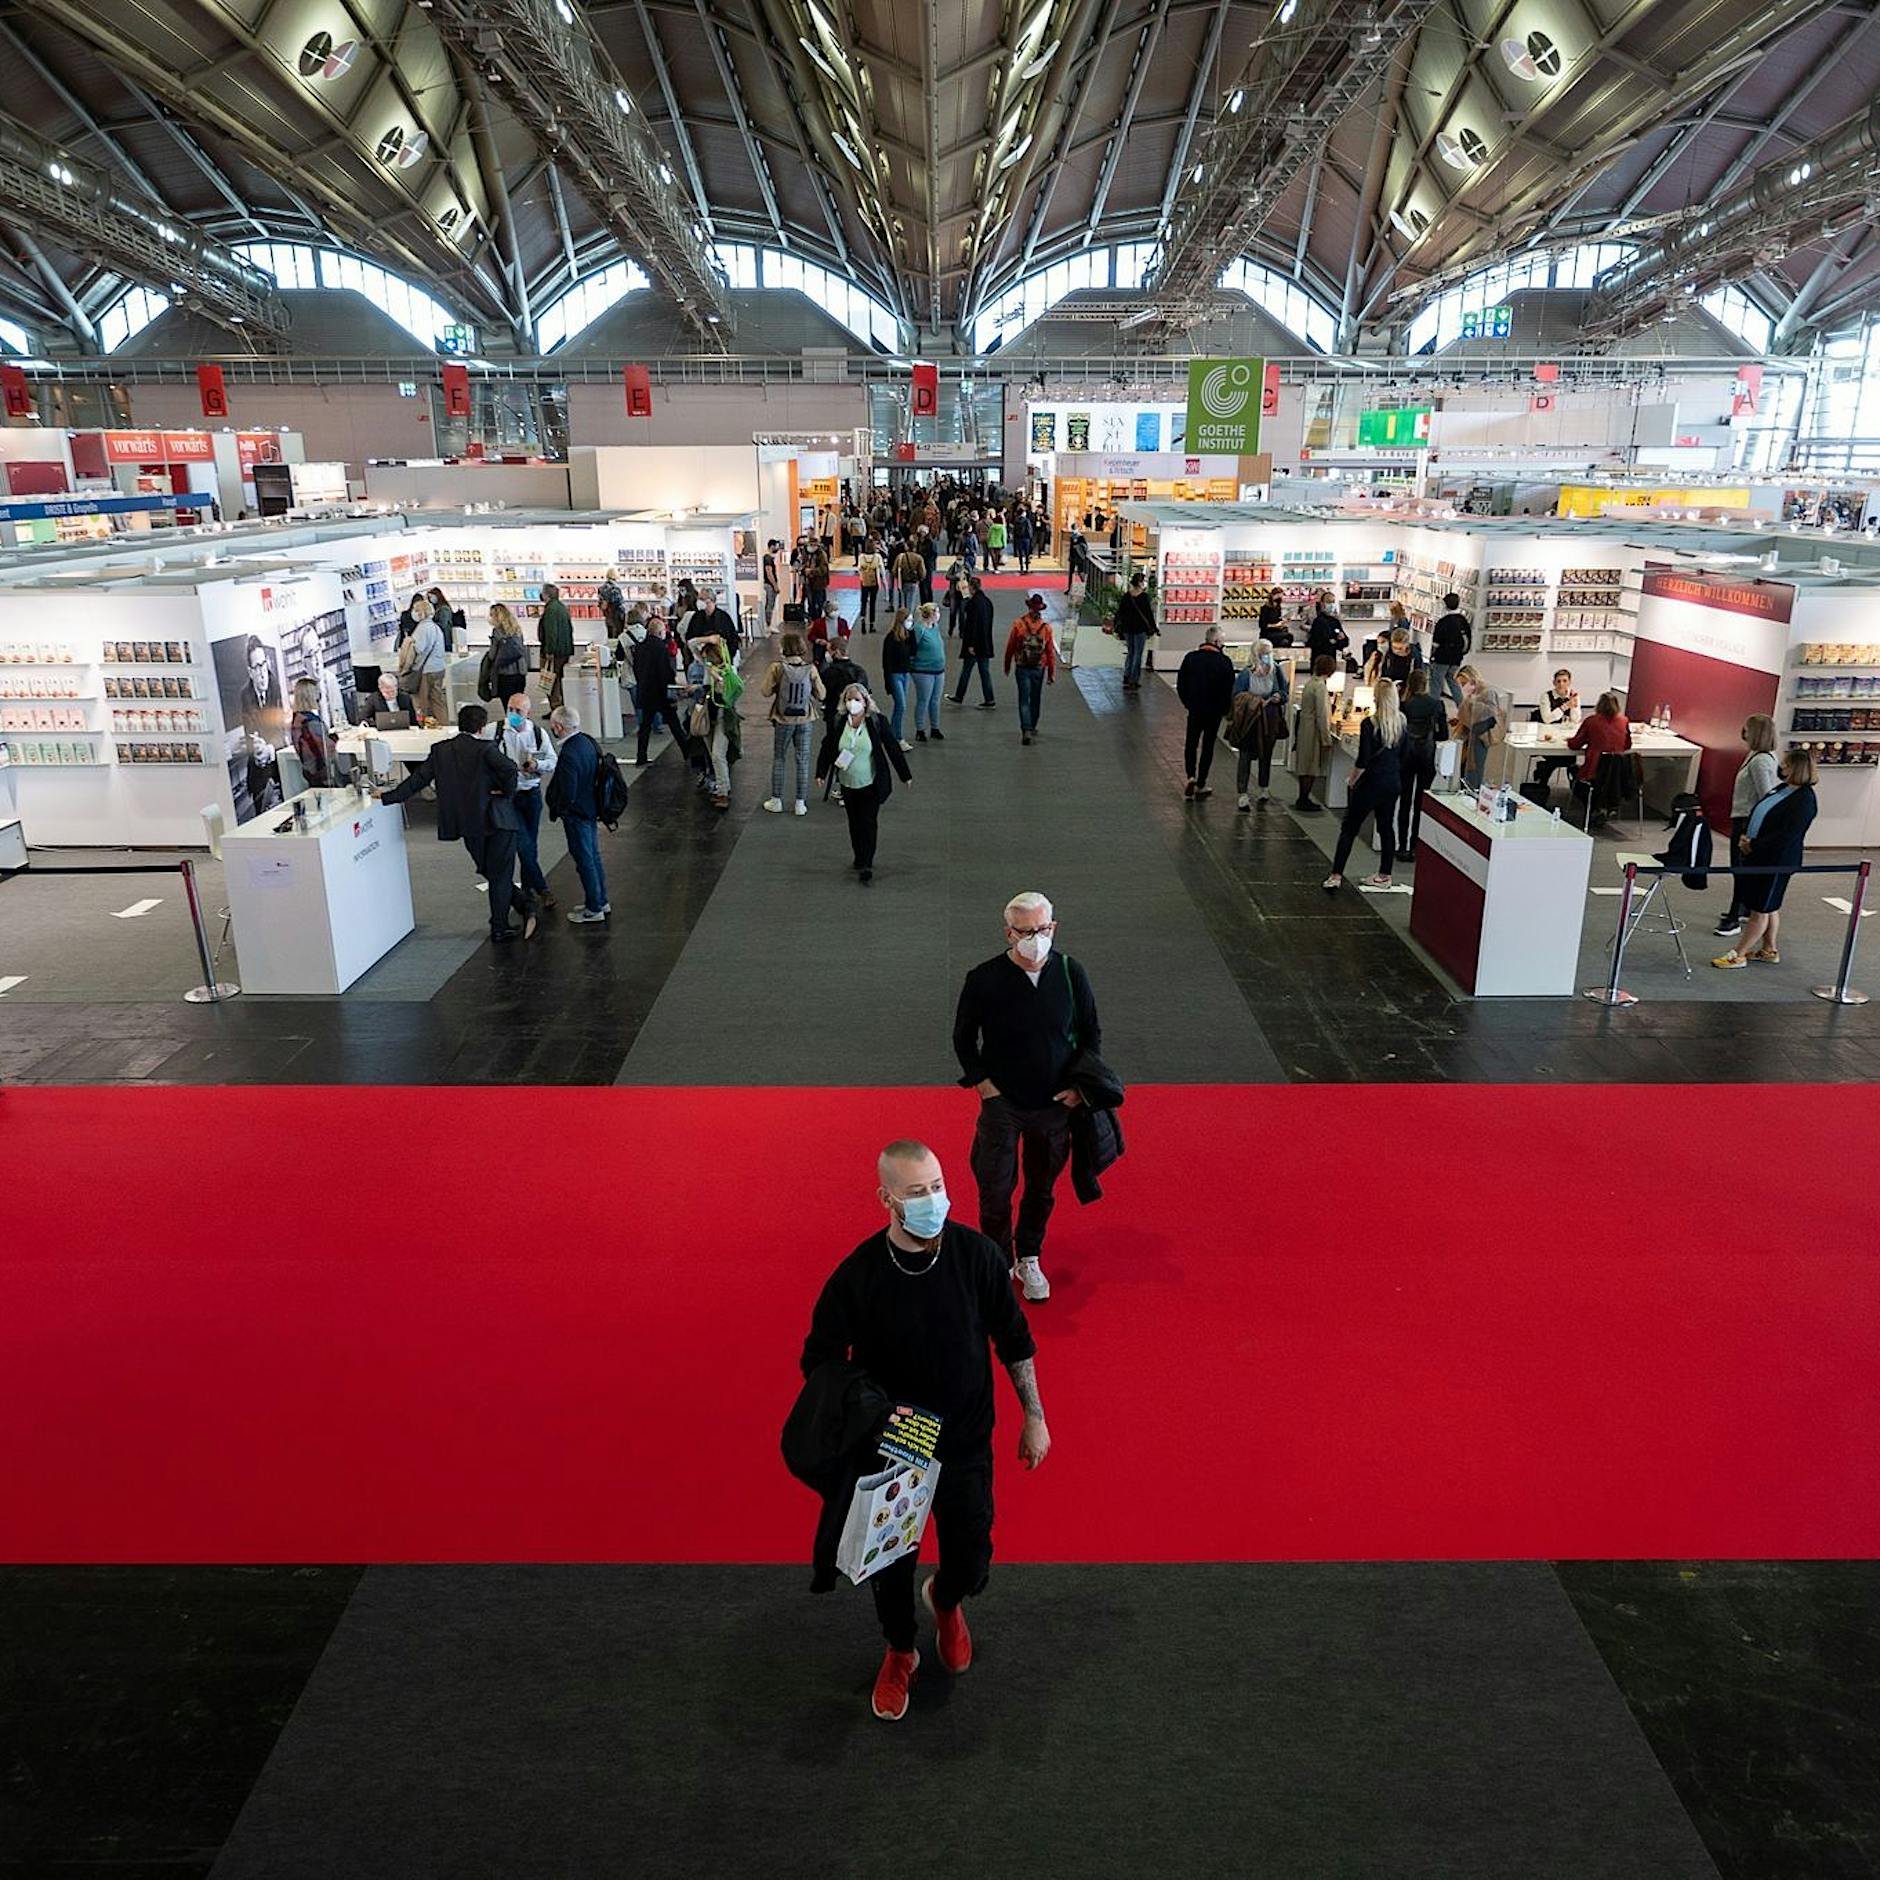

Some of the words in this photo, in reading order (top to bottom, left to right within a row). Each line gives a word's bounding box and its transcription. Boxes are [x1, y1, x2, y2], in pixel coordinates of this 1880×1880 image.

[8, 389, 25, 409] H
[207, 389, 221, 409] G
[451, 388, 463, 409] F
[632, 389, 645, 409] E
[918, 388, 932, 408] D
[1738, 388, 1754, 409] A
[1199, 424, 1246, 437] GOETHE
[112, 437, 158, 454] vorwärts
[170, 437, 209, 454] vorwärts
[1198, 438, 1246, 450] INSTITUT
[1656, 575, 1702, 597] HERZLICH
[1703, 585, 1776, 611] WILLKOMMEN
